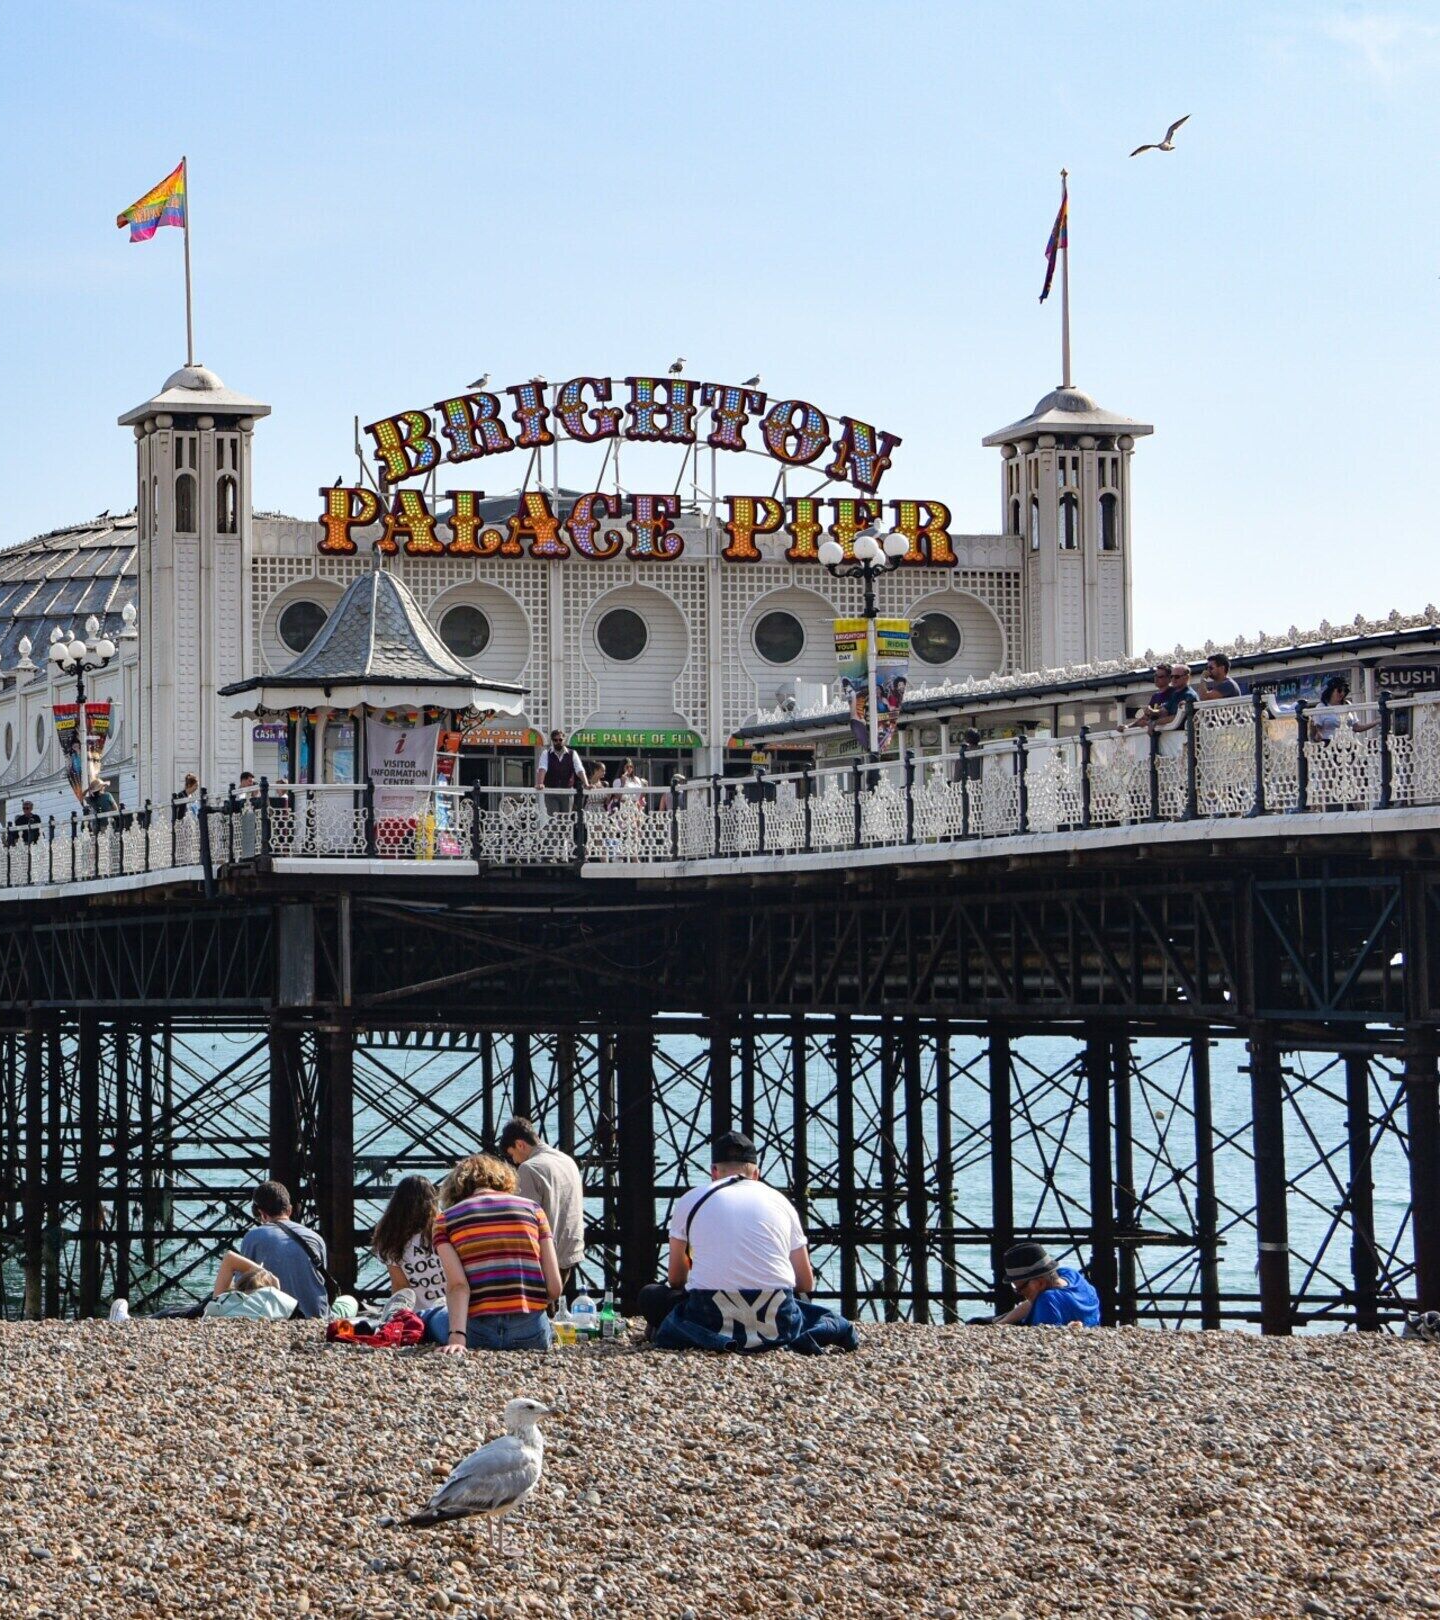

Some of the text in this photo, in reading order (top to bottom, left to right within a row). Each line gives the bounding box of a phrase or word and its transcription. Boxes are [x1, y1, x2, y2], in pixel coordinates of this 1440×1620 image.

[363, 376, 902, 495] BRIGHTON
[317, 486, 959, 568] PALACE PIER
[1379, 669, 1436, 686] SLUSH
[576, 733, 694, 744] THE PALACE OF FUN
[370, 768, 428, 778] INFORMATION
[383, 760, 416, 769] VISITOR
[712, 1289, 787, 1348] NY
